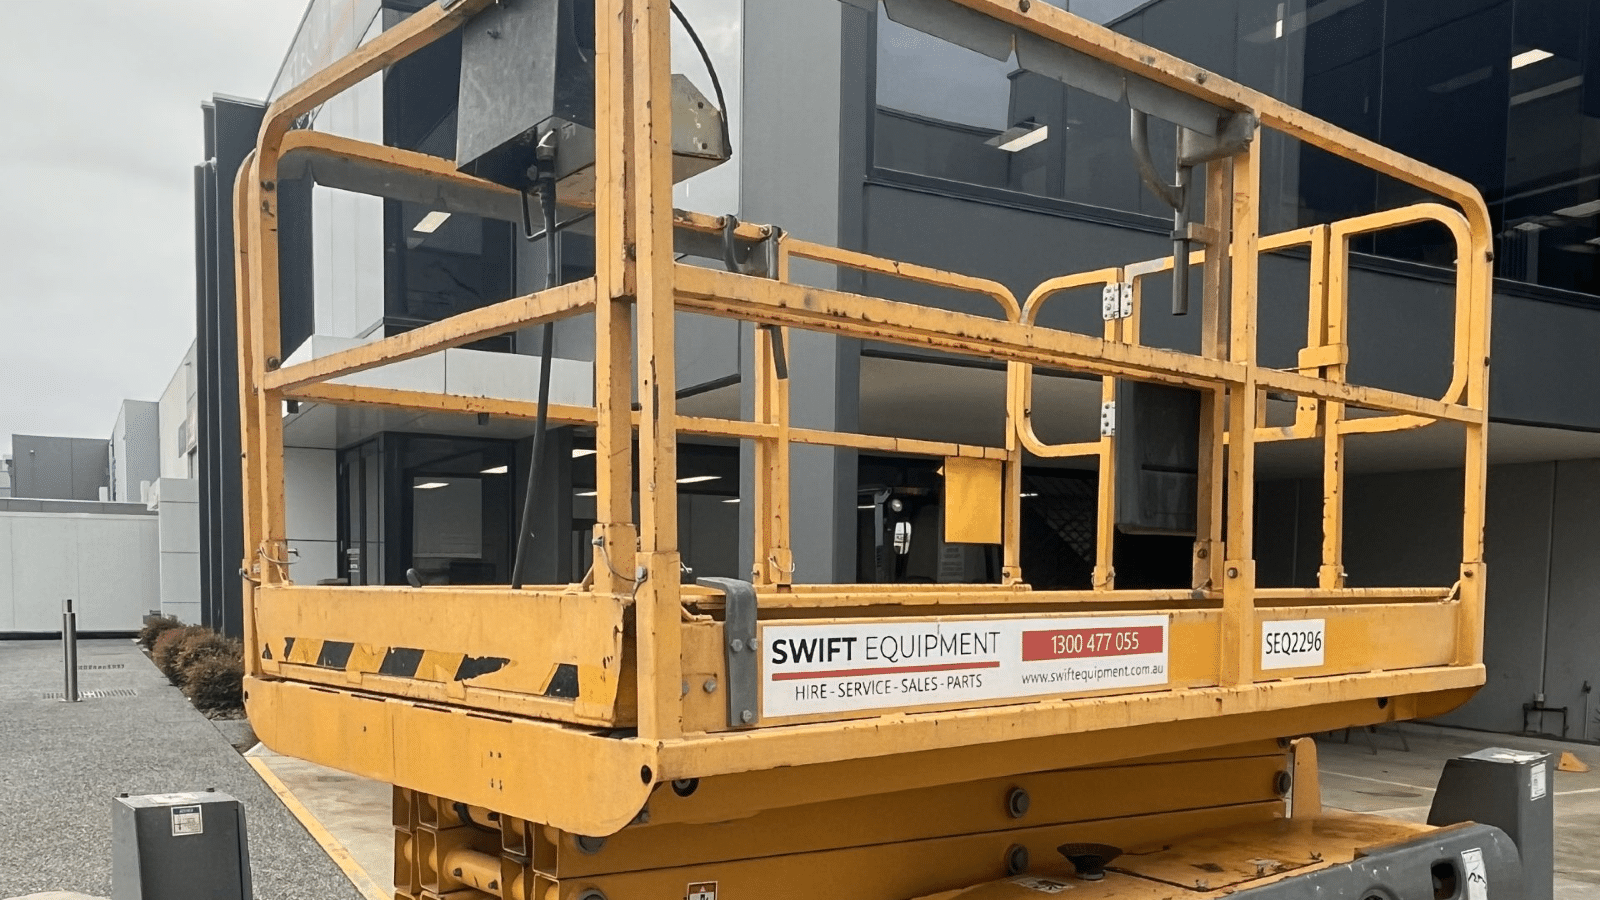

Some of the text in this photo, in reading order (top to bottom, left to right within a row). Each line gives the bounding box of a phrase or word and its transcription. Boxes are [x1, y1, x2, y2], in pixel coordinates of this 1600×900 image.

[771, 631, 1000, 664] SWIFT EQUIPMENT
[1051, 631, 1140, 654] 1300 477 055
[1265, 630, 1322, 655] SEQ2296
[795, 683, 827, 700] HIRE
[838, 679, 891, 698] SERVICE
[901, 676, 938, 693] SALES
[947, 673, 983, 690] PARTS
[1021, 664, 1164, 685] www.swiftequipment.com.au
